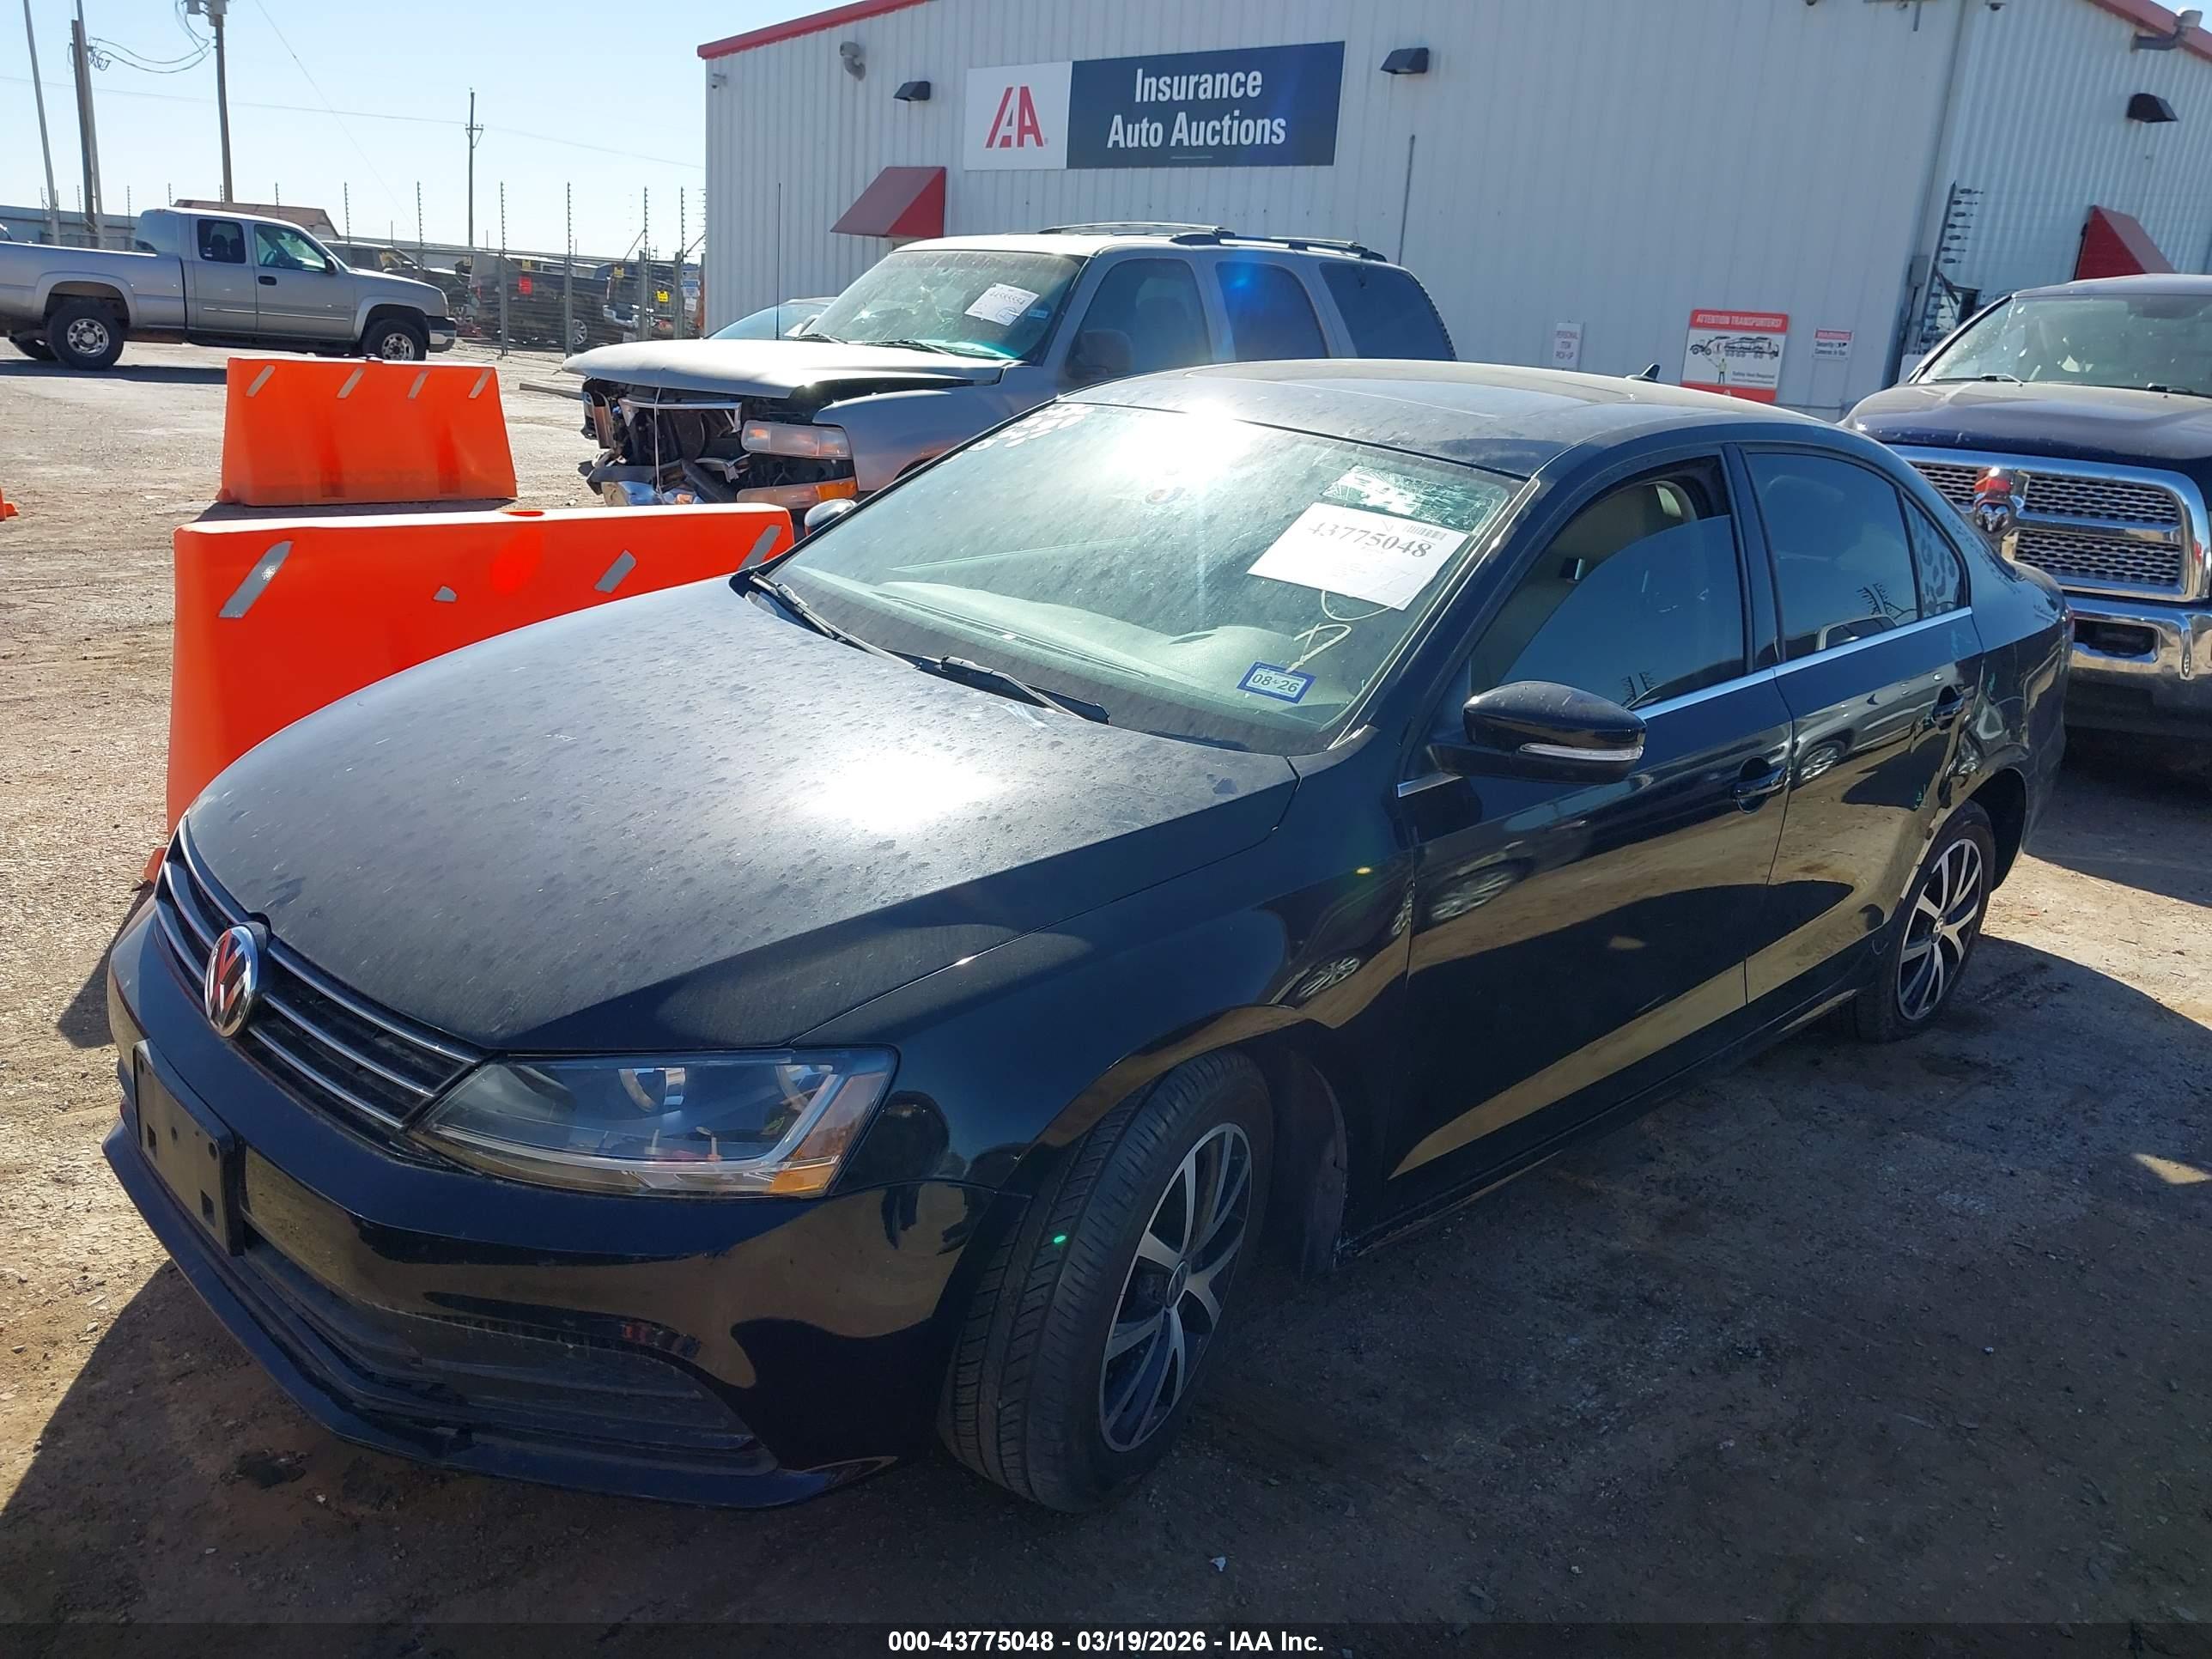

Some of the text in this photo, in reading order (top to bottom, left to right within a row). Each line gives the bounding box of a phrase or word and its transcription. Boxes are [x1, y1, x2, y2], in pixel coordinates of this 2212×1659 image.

[1134, 68, 1263, 103] Insurance
[1106, 109, 1287, 149] Auto Auctions
[1308, 522, 1433, 557] 43775048
